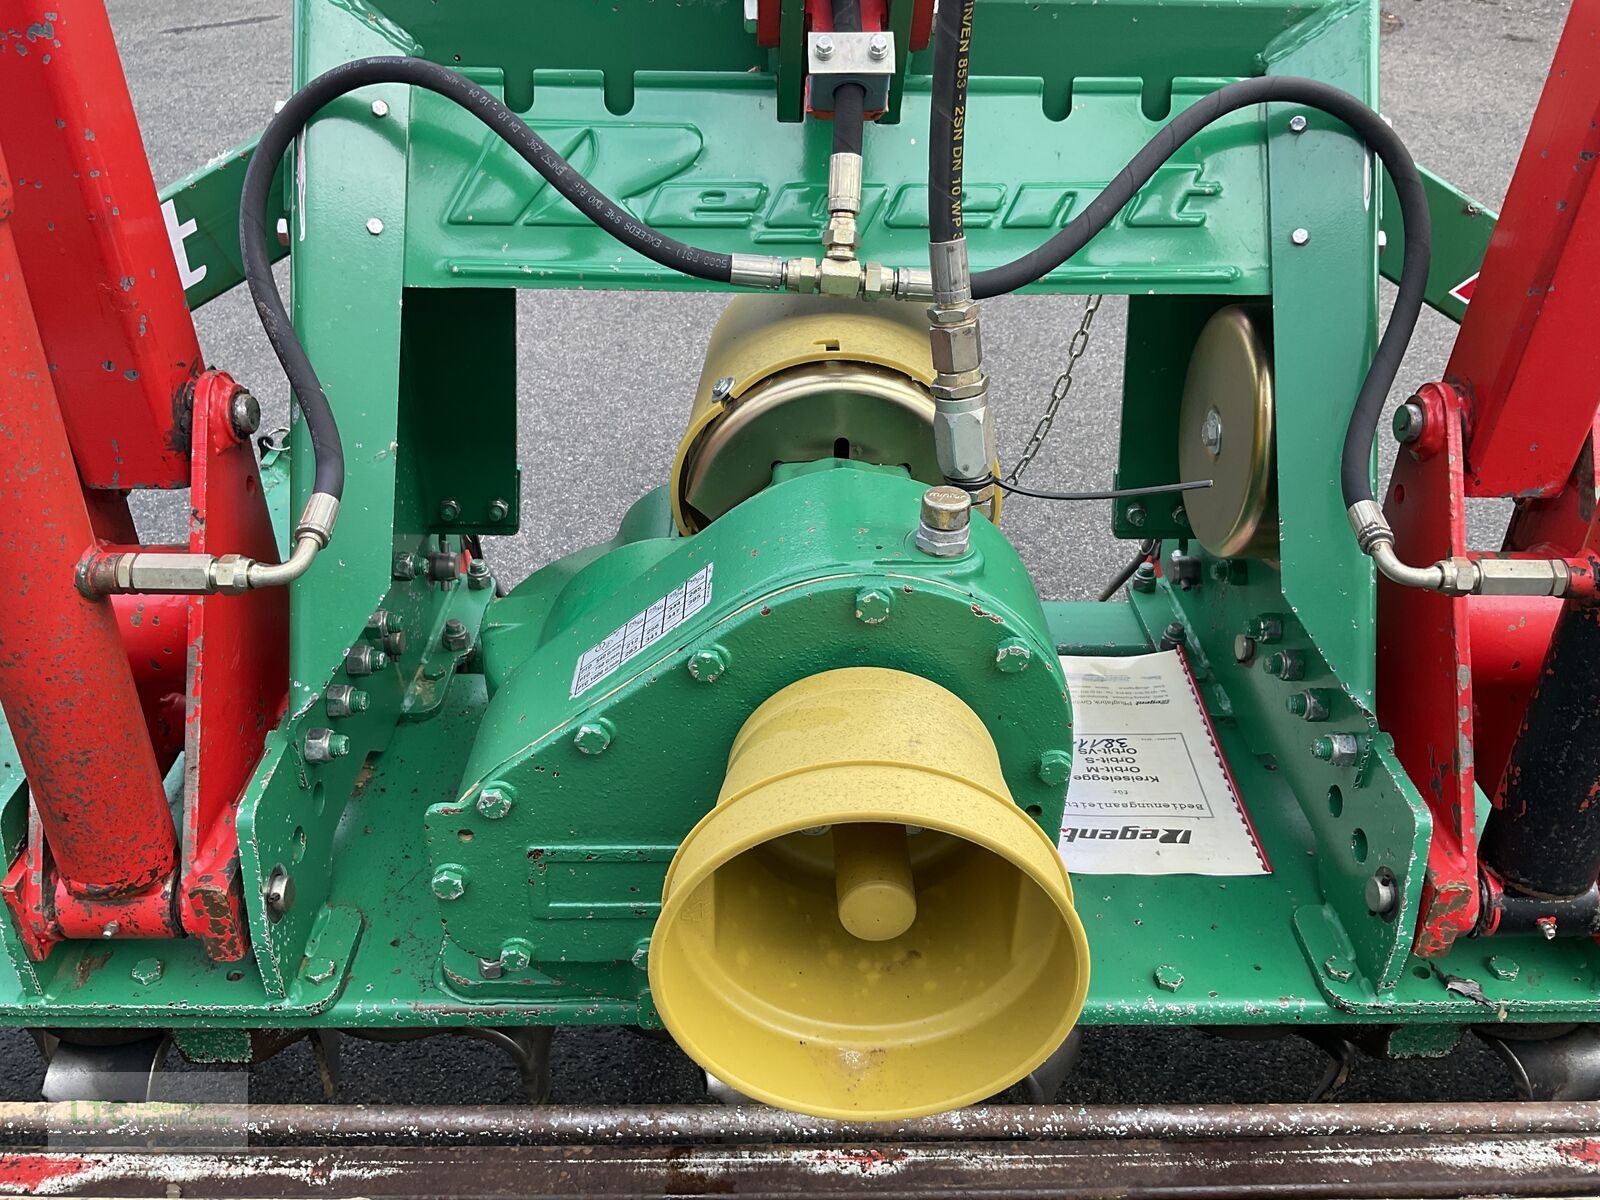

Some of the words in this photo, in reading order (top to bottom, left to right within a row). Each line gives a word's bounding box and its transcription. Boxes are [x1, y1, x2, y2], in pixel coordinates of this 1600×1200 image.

[959, 0, 974, 52] IN/EN
[956, 59, 968, 89] 853
[498, 111, 509, 122] 10
[953, 106, 964, 140] 2SN
[952, 147, 962, 172] DN
[951, 177, 962, 196] 10
[951, 199, 962, 228] WP
[624, 222, 662, 248] EXCEEDS
[1073, 774, 1159, 783] Kreiselegge
[1067, 800, 1204, 811] Bedienungsanleitu
[1064, 825, 1192, 844] Regent
